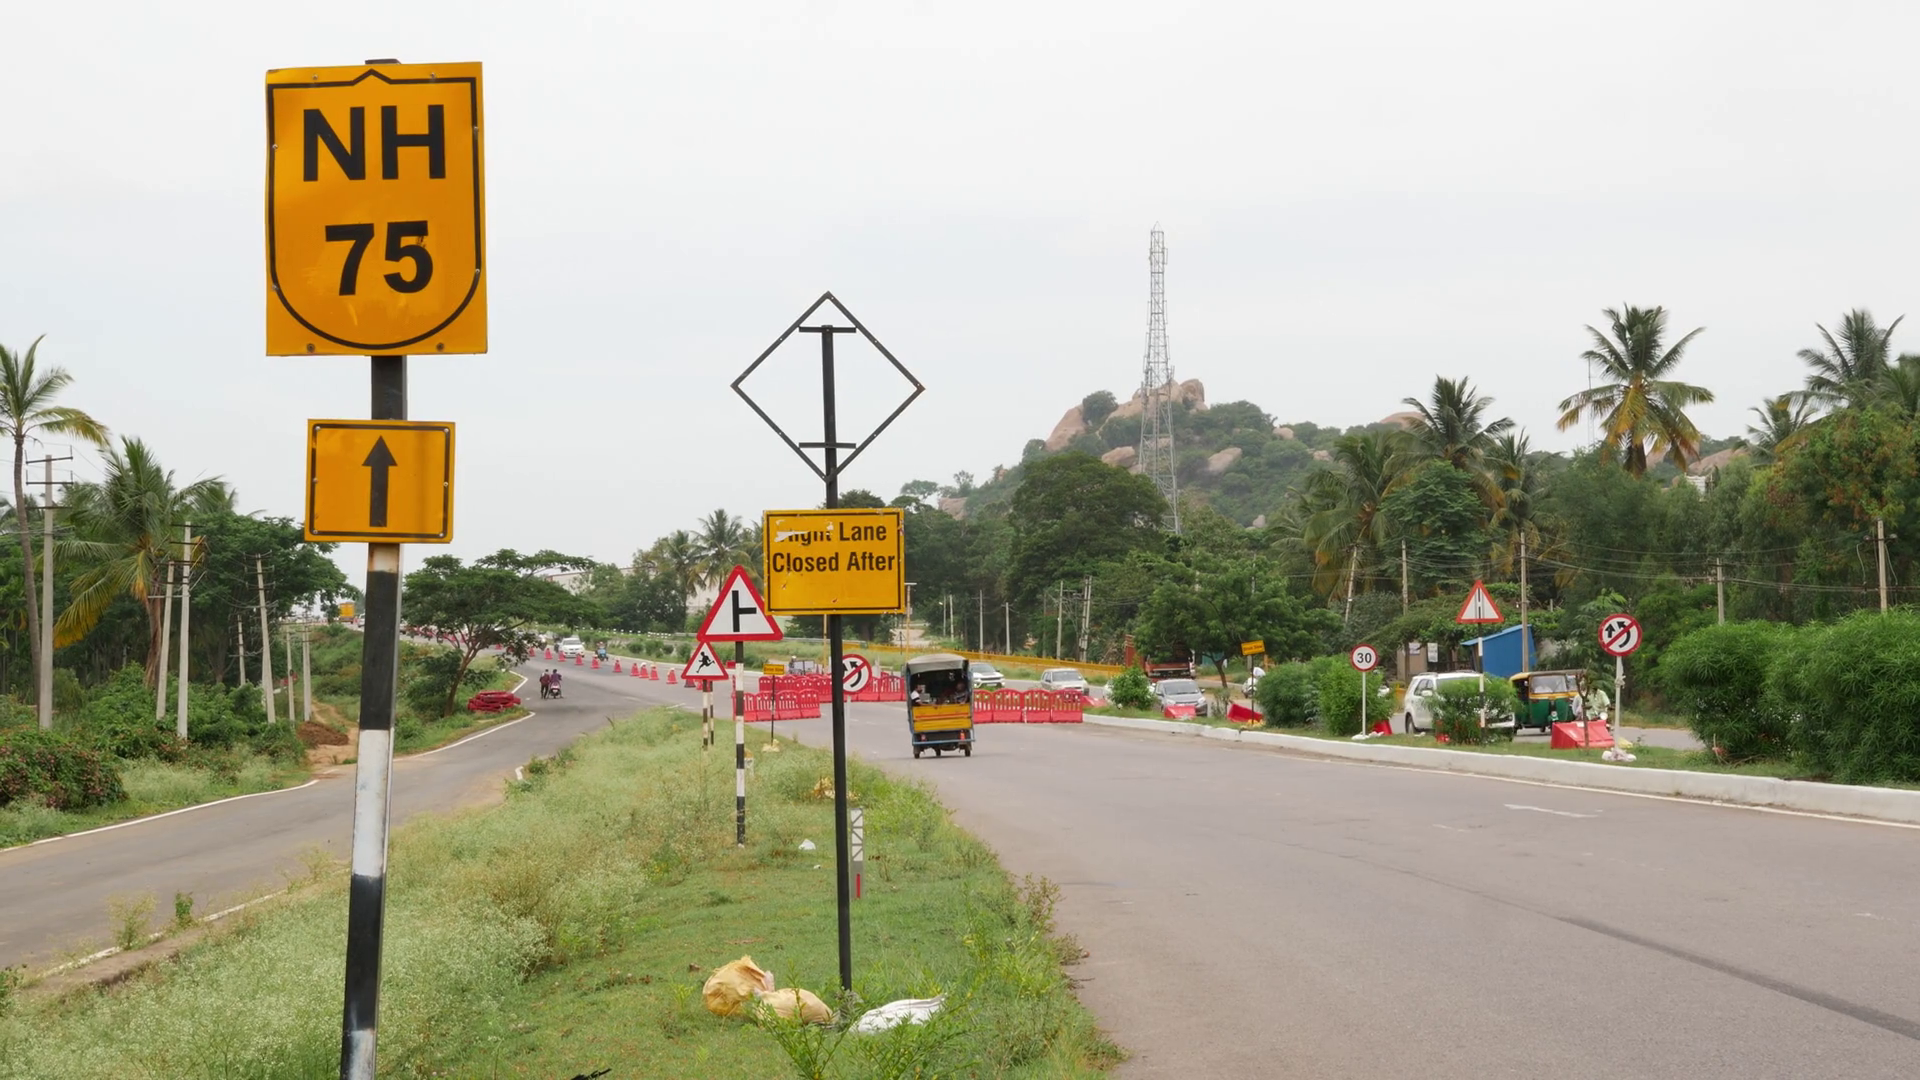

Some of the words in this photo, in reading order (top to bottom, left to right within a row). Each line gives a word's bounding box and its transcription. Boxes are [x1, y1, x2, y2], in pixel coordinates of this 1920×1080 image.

[304, 104, 446, 182] NH
[325, 220, 434, 296] 75
[839, 522, 887, 541] Lane
[773, 552, 839, 573] Closed
[847, 551, 895, 571] After
[1357, 653, 1372, 664] 30
